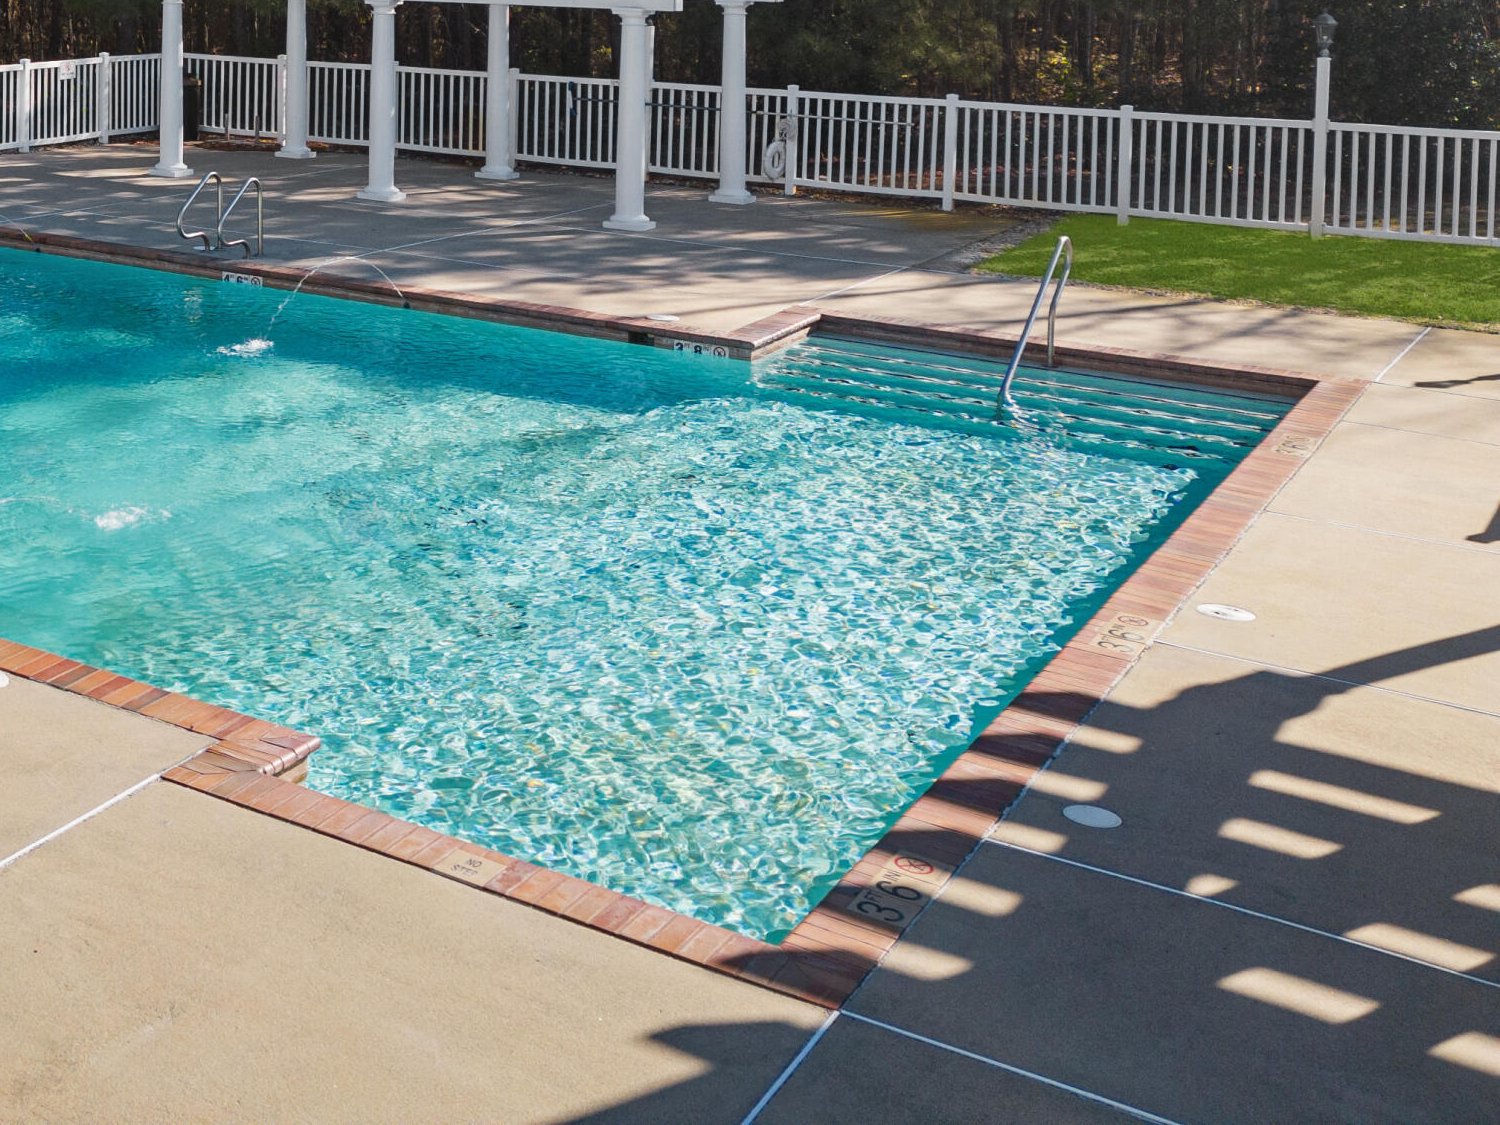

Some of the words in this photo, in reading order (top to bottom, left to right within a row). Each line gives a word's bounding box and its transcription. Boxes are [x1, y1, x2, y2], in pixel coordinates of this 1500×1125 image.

[1107, 629, 1145, 641] 6
[1097, 640, 1135, 653] 3
[882, 870, 901, 882] IN
[864, 888, 883, 903] FT
[875, 880, 922, 901] 6
[856, 900, 905, 923] 3
